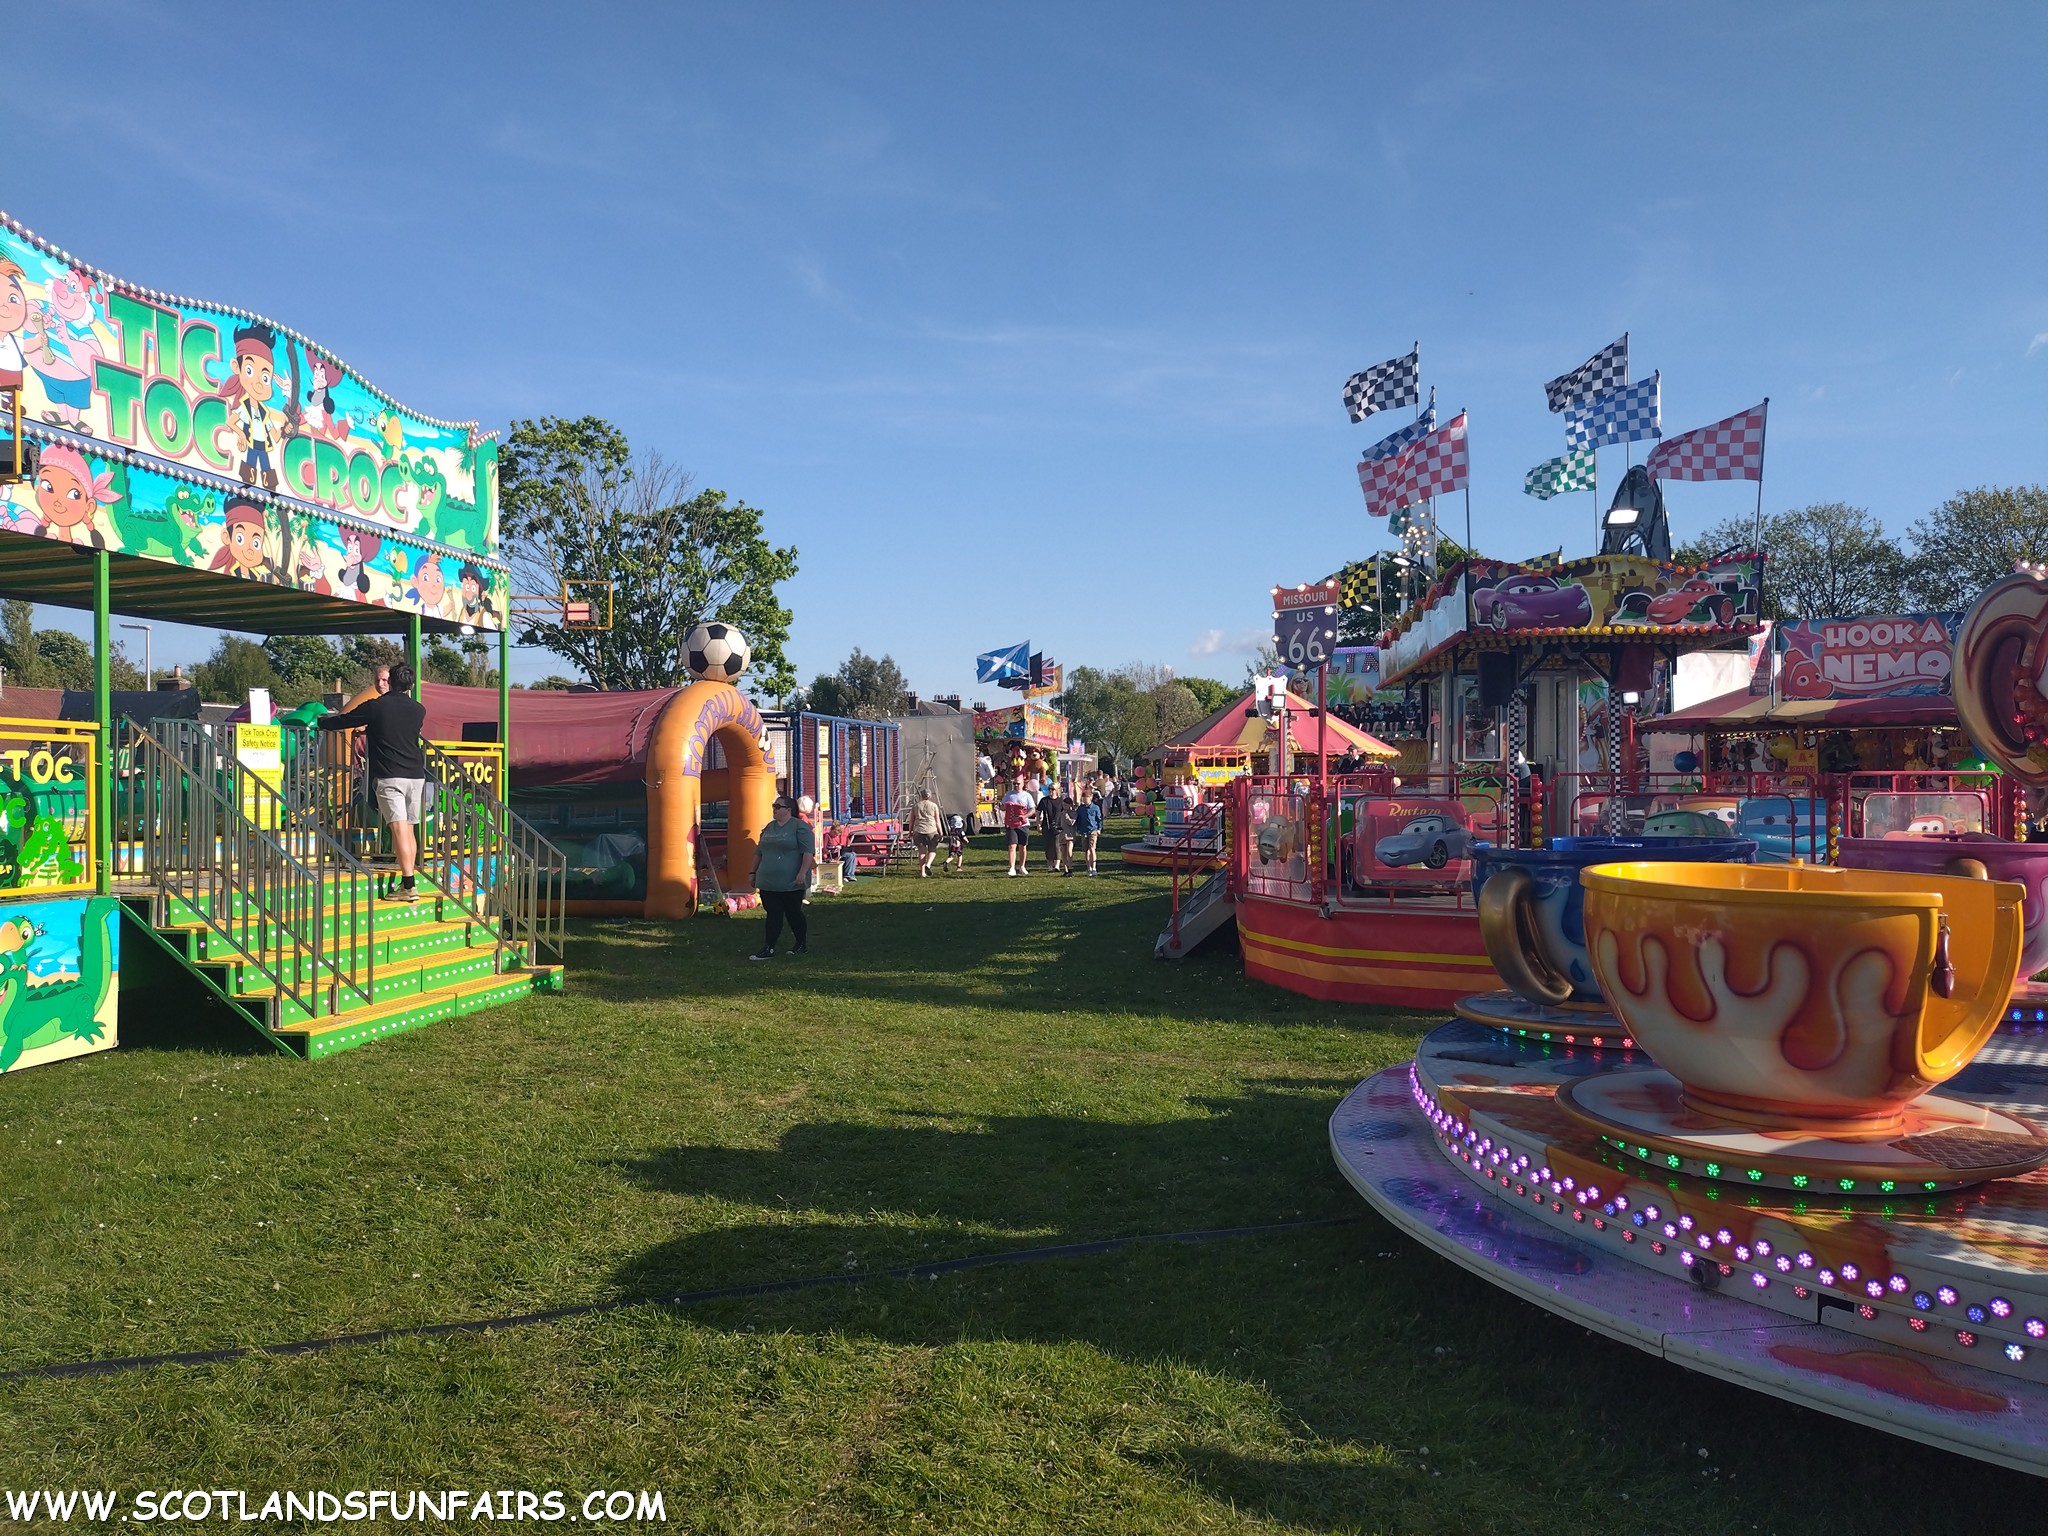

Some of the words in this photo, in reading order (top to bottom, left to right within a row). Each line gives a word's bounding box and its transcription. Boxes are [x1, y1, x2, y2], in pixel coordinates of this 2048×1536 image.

[106, 290, 222, 394] TIC
[93, 358, 233, 470] TOC
[282, 434, 410, 523] CROC
[1283, 591, 1328, 605] MISSOURI
[1296, 611, 1314, 622] US
[1288, 626, 1324, 664] 66
[1825, 623, 1915, 648] HOOK
[1920, 621, 1943, 642] A
[1823, 650, 1951, 682] NEMO
[260, 740, 276, 748] Notice
[682, 689, 735, 779] FOOTBALL
